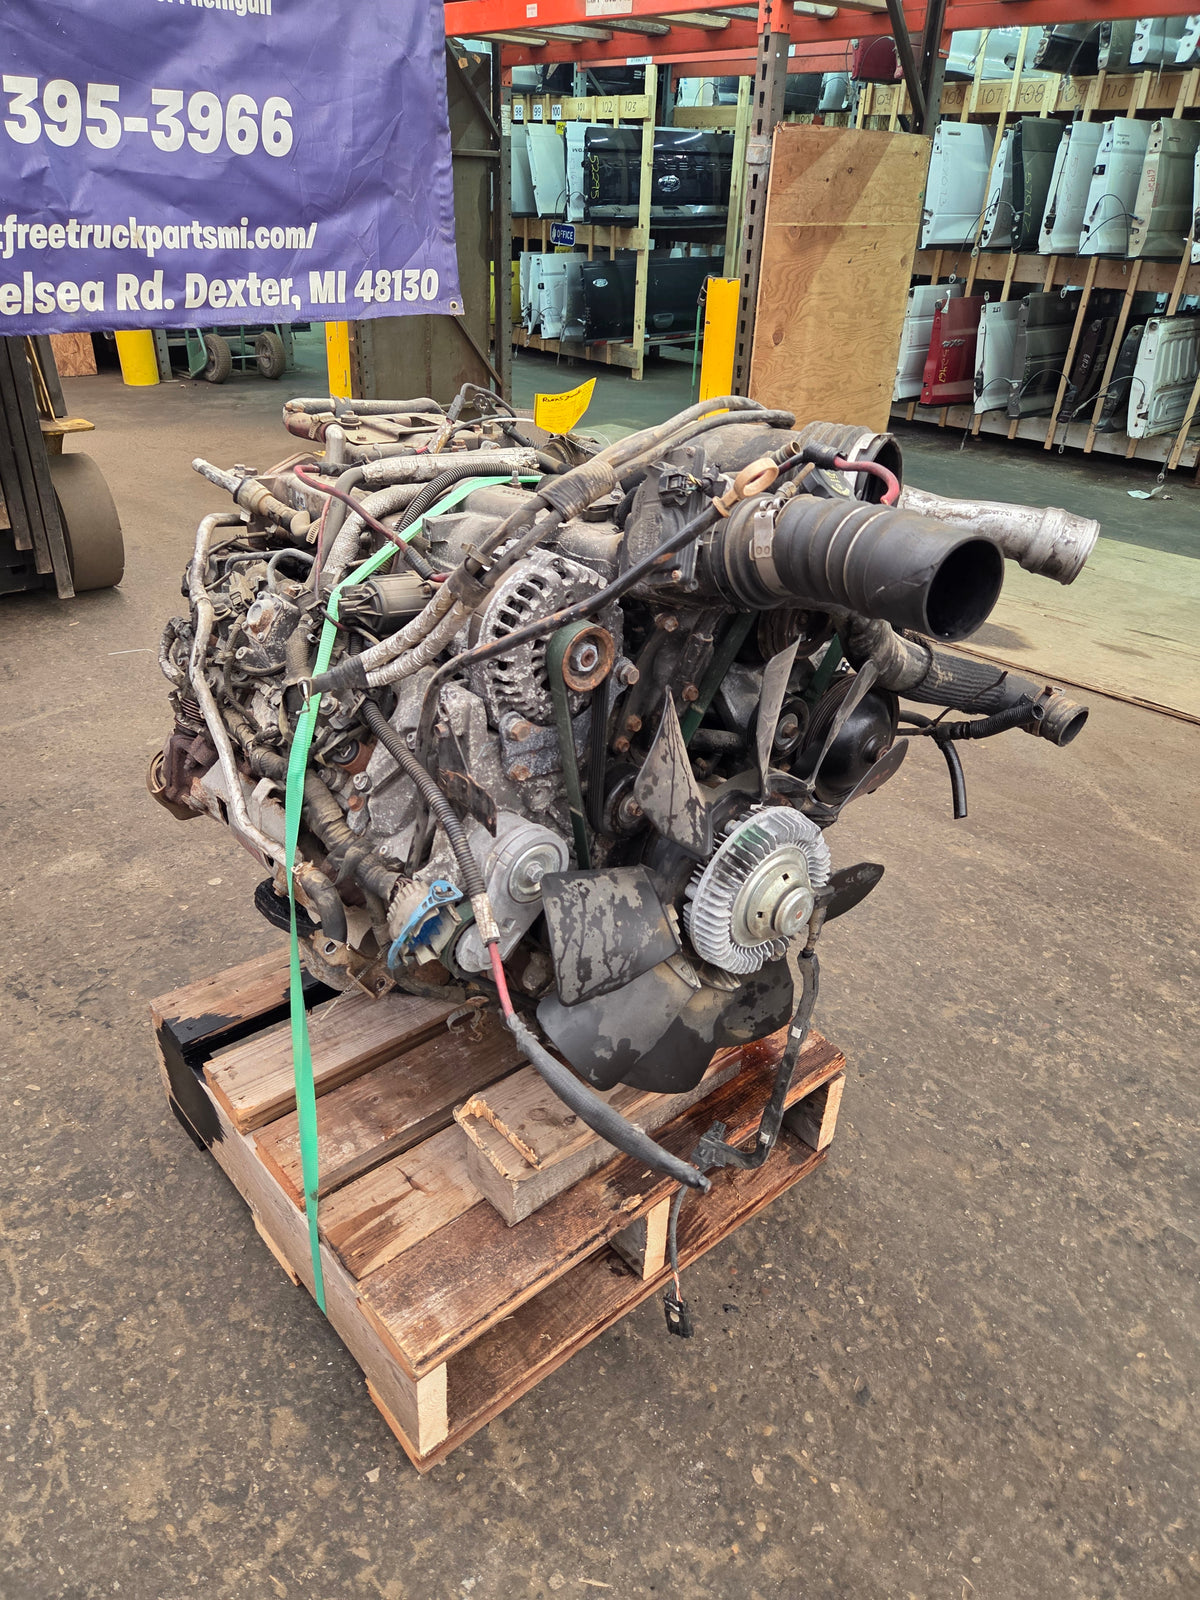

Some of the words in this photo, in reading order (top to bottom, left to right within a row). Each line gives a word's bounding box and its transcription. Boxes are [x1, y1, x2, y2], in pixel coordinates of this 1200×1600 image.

[981, 87, 1003, 105] 107
[514, 106, 523, 117] 98
[533, 106, 542, 117] 99
[552, 106, 561, 117] 100
[602, 100, 613, 114] 102
[624, 100, 637, 113] 103
[2, 74, 293, 158] 395-3966
[589, 155, 600, 200] 52295
[0, 214, 318, 259] freetruckpartsmi.com/
[556, 229, 574, 241] OFFICE
[0, 271, 105, 316] elsea
[116, 269, 176, 311] Rd.
[184, 272, 301, 311] Dexter,
[308, 270, 347, 304] MI
[353, 268, 440, 303] 48130
